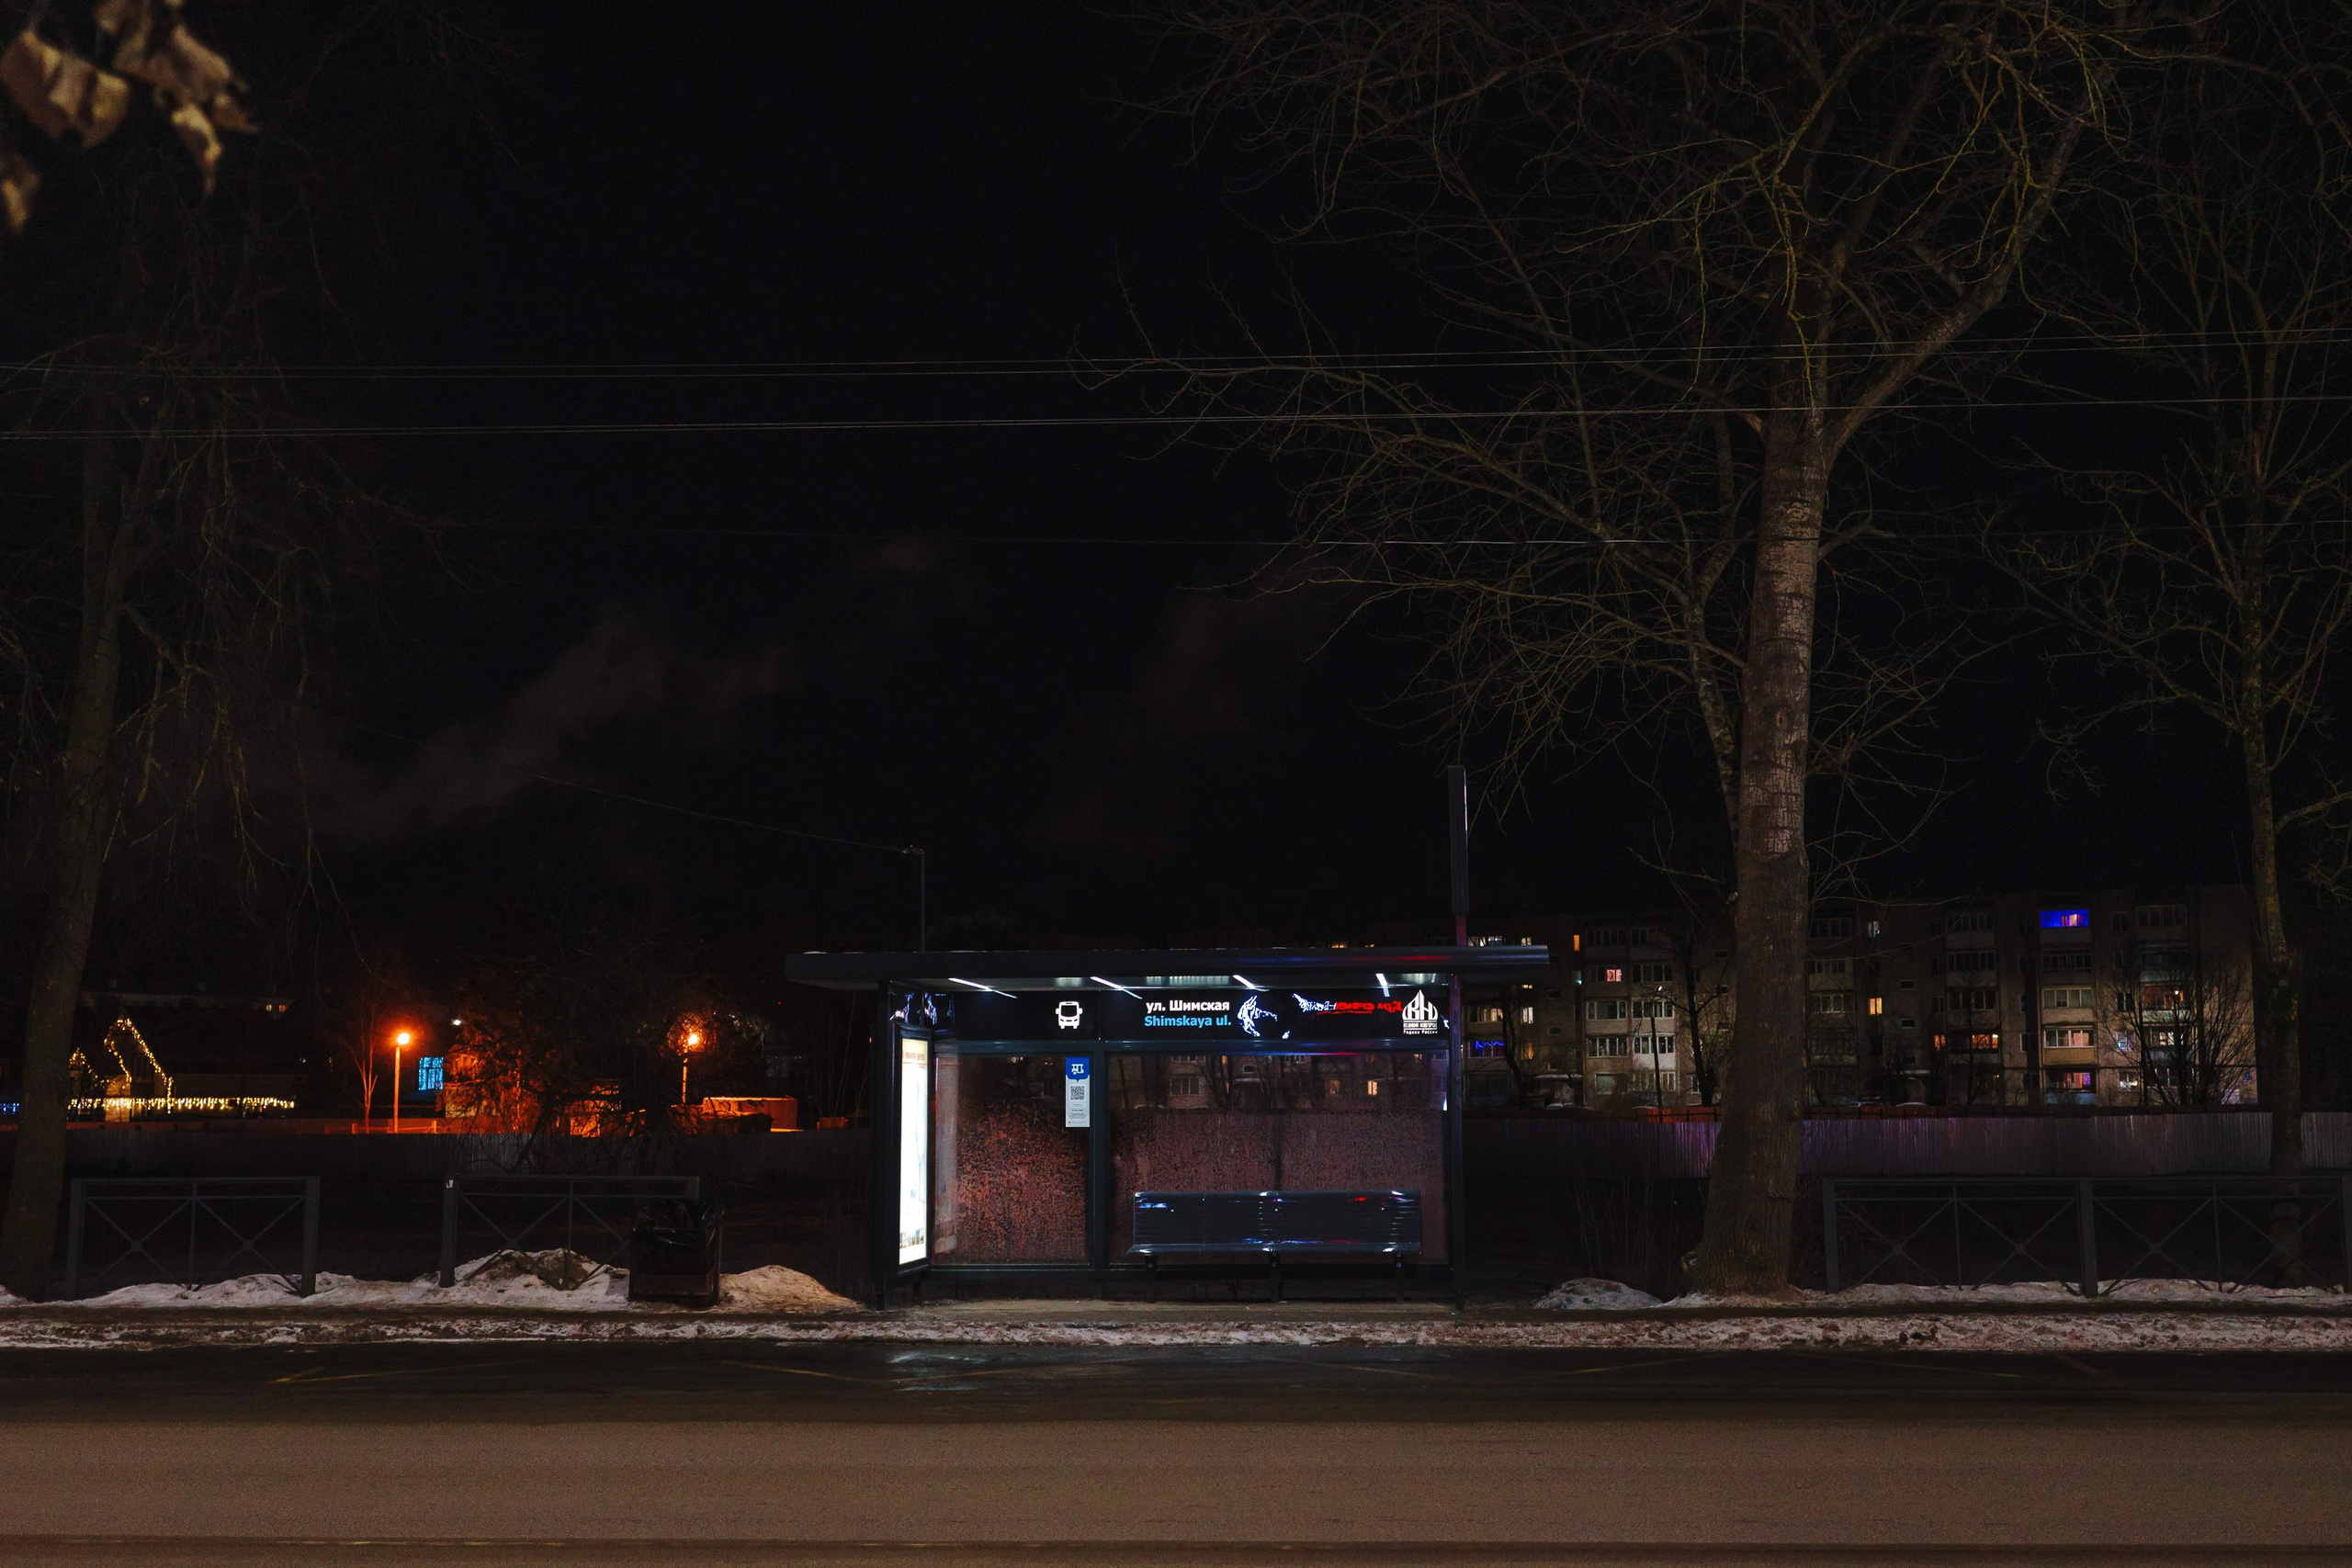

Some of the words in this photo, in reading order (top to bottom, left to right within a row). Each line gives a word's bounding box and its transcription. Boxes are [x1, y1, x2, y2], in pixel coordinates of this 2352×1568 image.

[1146, 1001, 1166, 1013] ул.
[1170, 999, 1230, 1011] Шимская
[1144, 1014, 1213, 1028] Shimskaya
[1216, 1015, 1232, 1026] ul.
